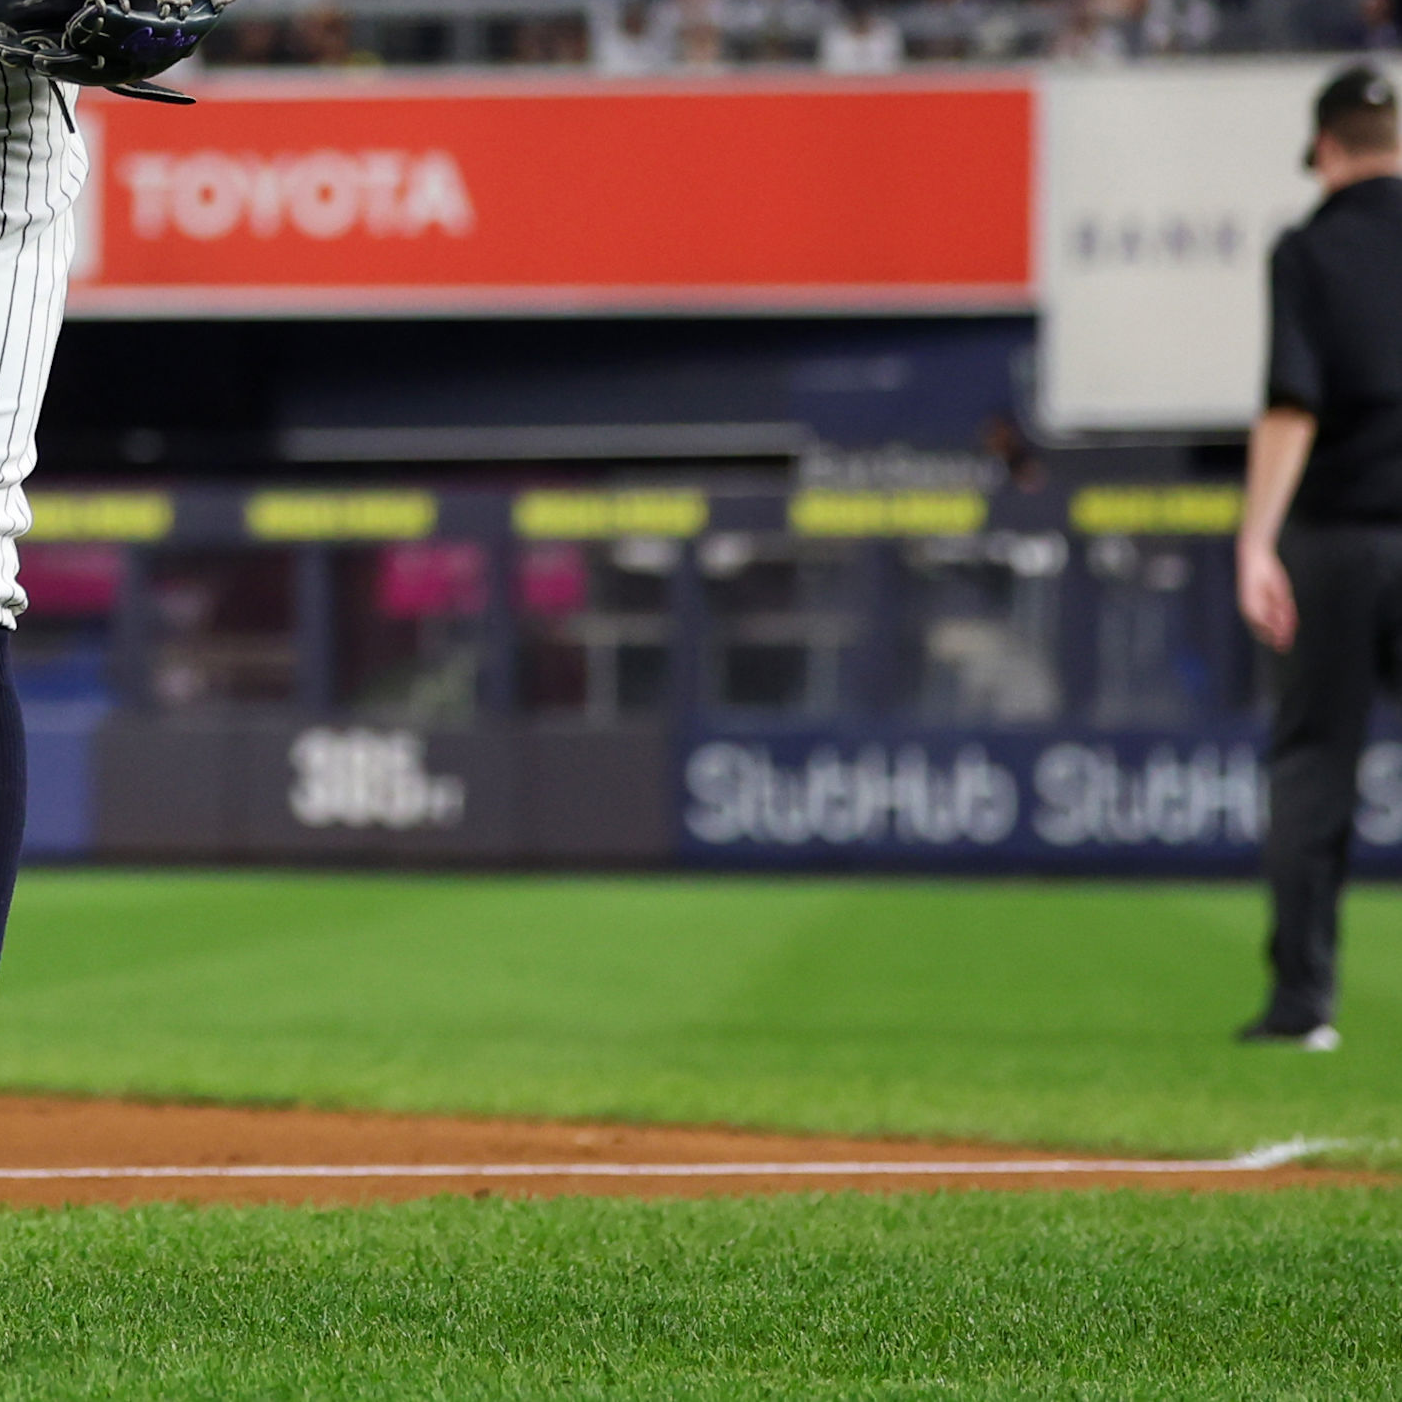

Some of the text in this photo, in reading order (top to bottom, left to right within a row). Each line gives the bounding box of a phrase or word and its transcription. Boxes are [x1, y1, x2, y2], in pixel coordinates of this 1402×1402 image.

[117, 148, 478, 240] TOYOTA
[685, 741, 1018, 844] StubHub
[1033, 741, 1272, 844] StubH
